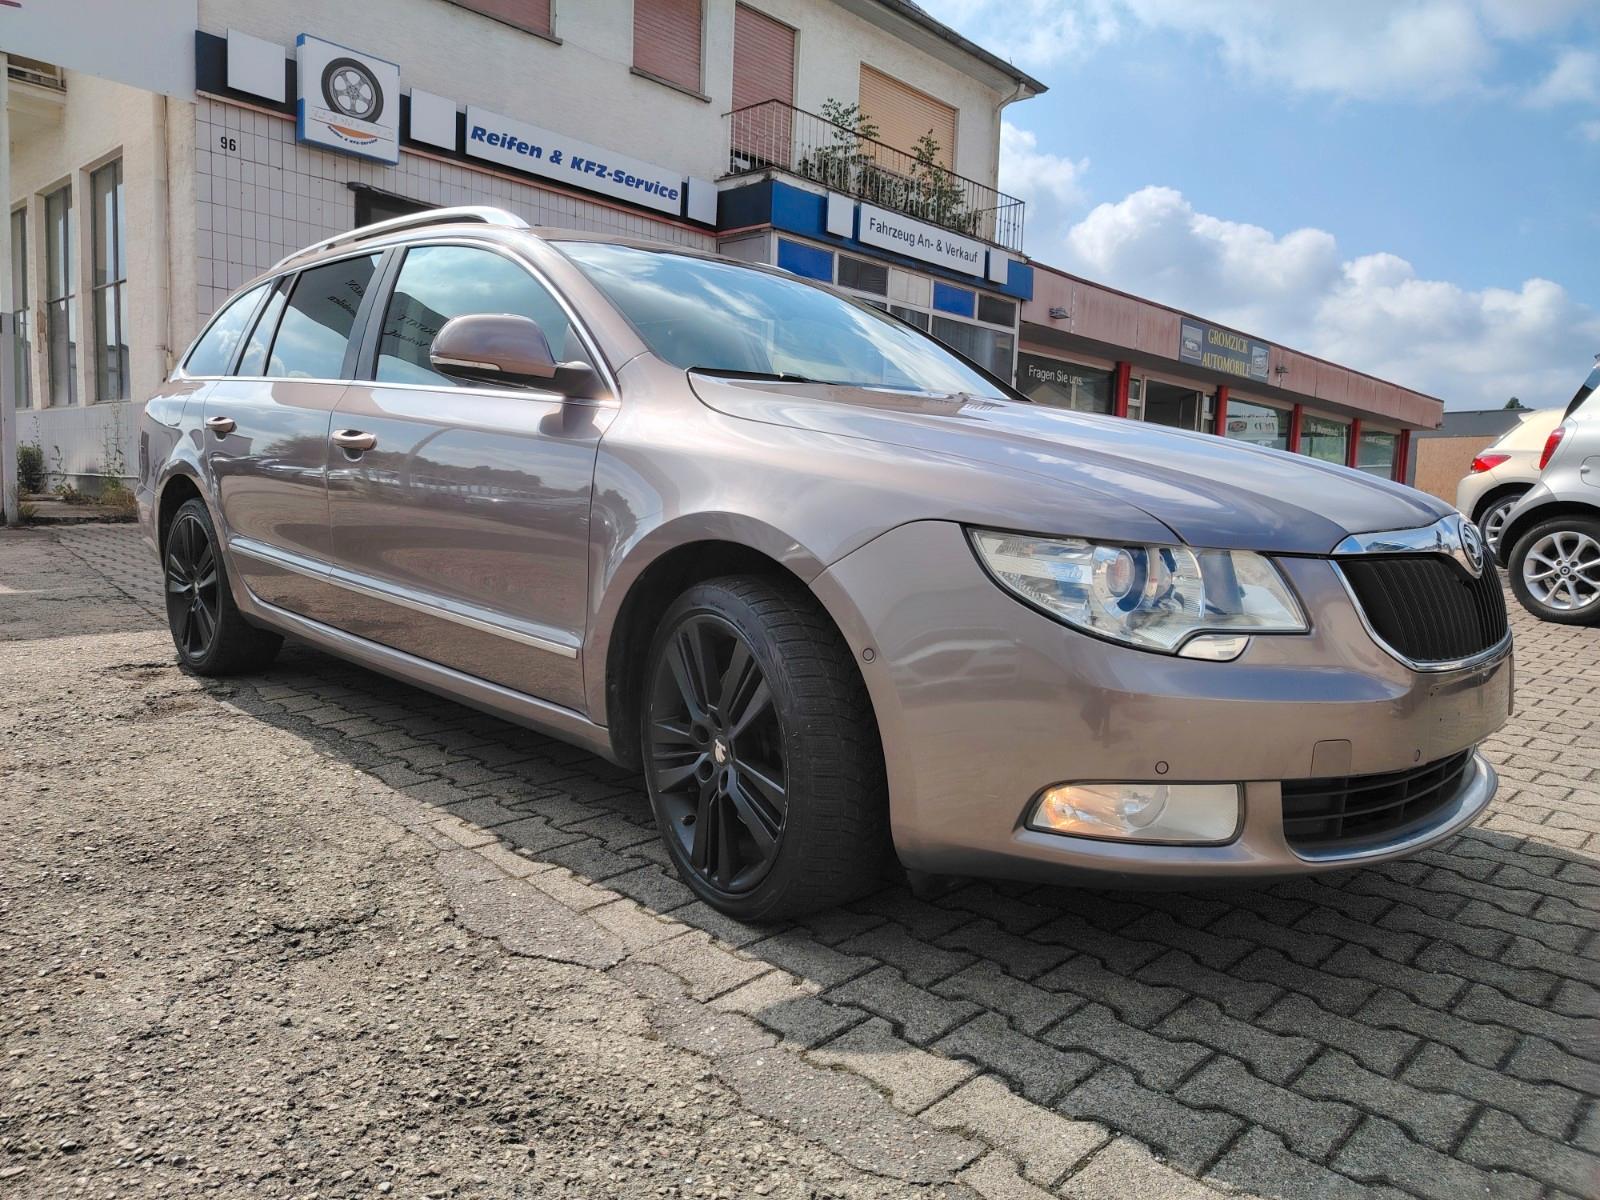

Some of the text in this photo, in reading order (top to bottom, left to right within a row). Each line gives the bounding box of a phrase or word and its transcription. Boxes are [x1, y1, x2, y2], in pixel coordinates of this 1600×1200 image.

[220, 136, 236, 151] 96
[471, 126, 679, 200] Reifen & KFZ-Service
[869, 217, 978, 263] Fahrzeug An- & Verkauf
[1207, 328, 1249, 354] GROMZICK
[1028, 364, 1055, 382] Fragen
[1056, 370, 1068, 383] Sie
